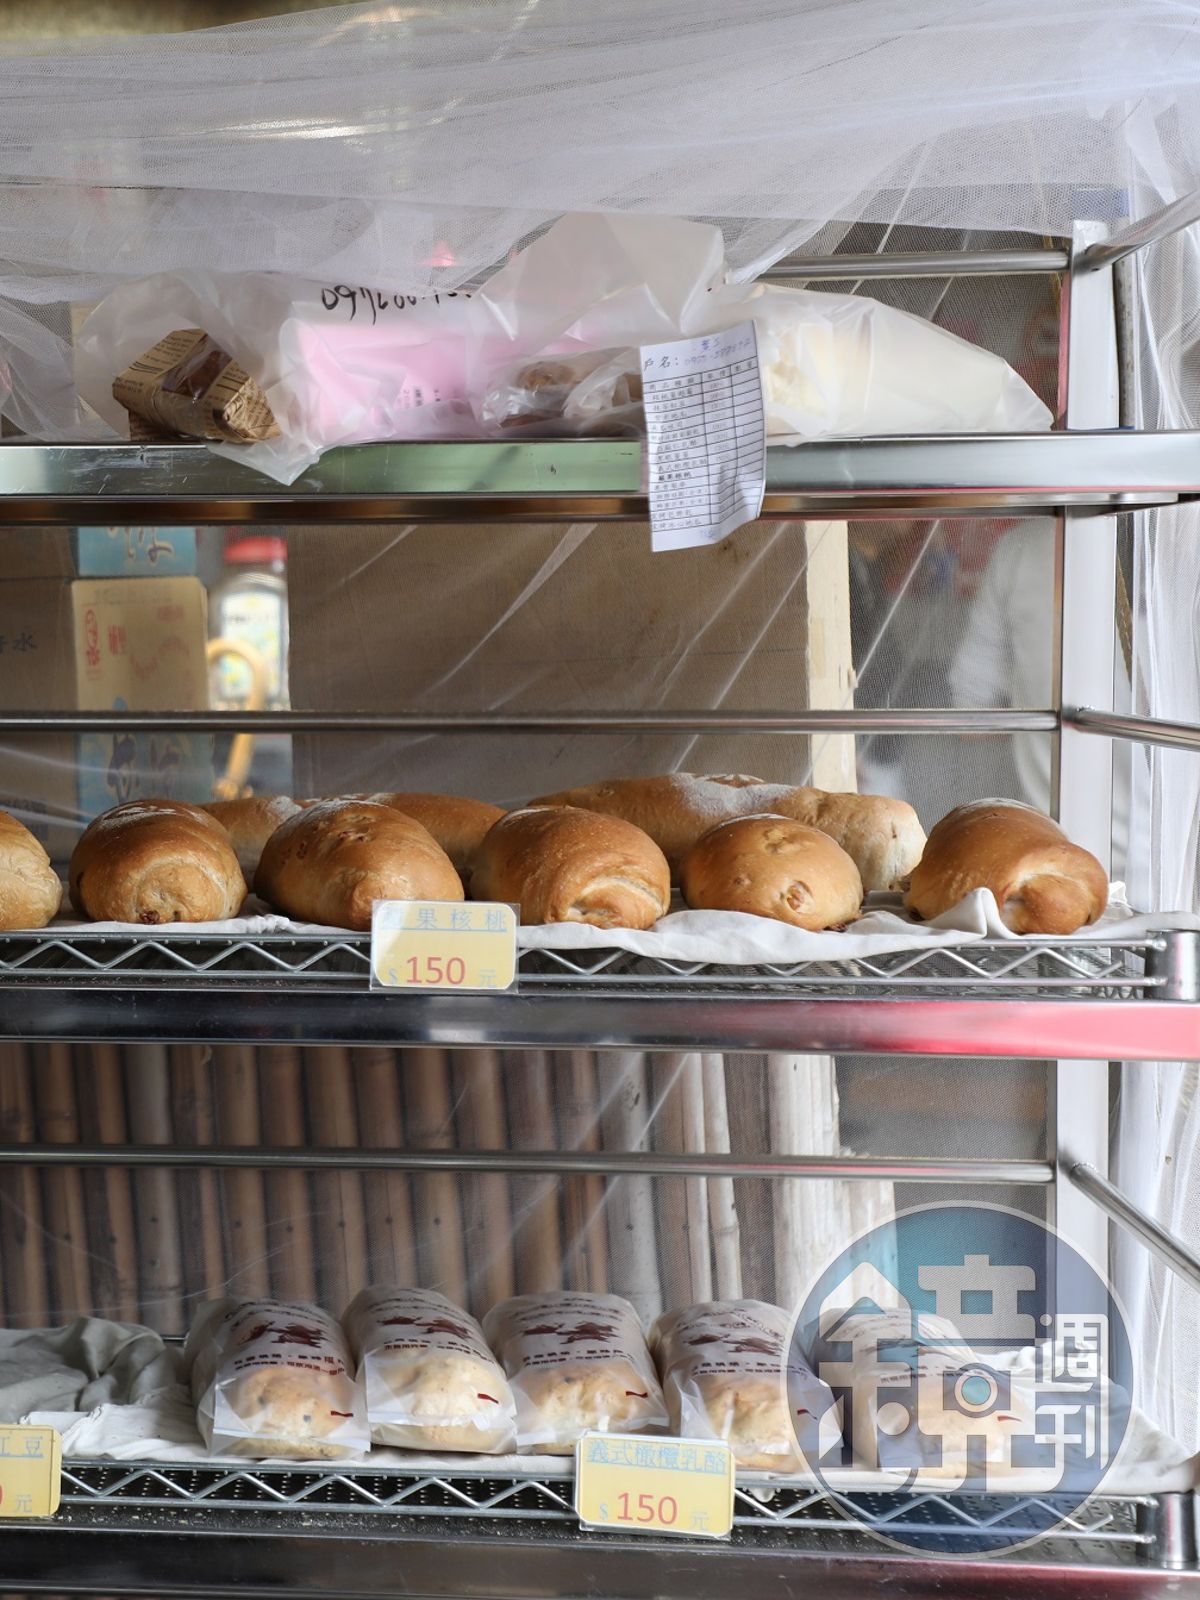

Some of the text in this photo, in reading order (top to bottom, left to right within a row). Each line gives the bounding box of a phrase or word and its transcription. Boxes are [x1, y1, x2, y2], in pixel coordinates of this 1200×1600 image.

[406, 956, 466, 985] 150
[587, 1439, 727, 1474] 義式橄欖乳酪
[15, 1494, 33, 1513] 元
[617, 1492, 678, 1525] 150
[689, 1511, 709, 1531] 元
